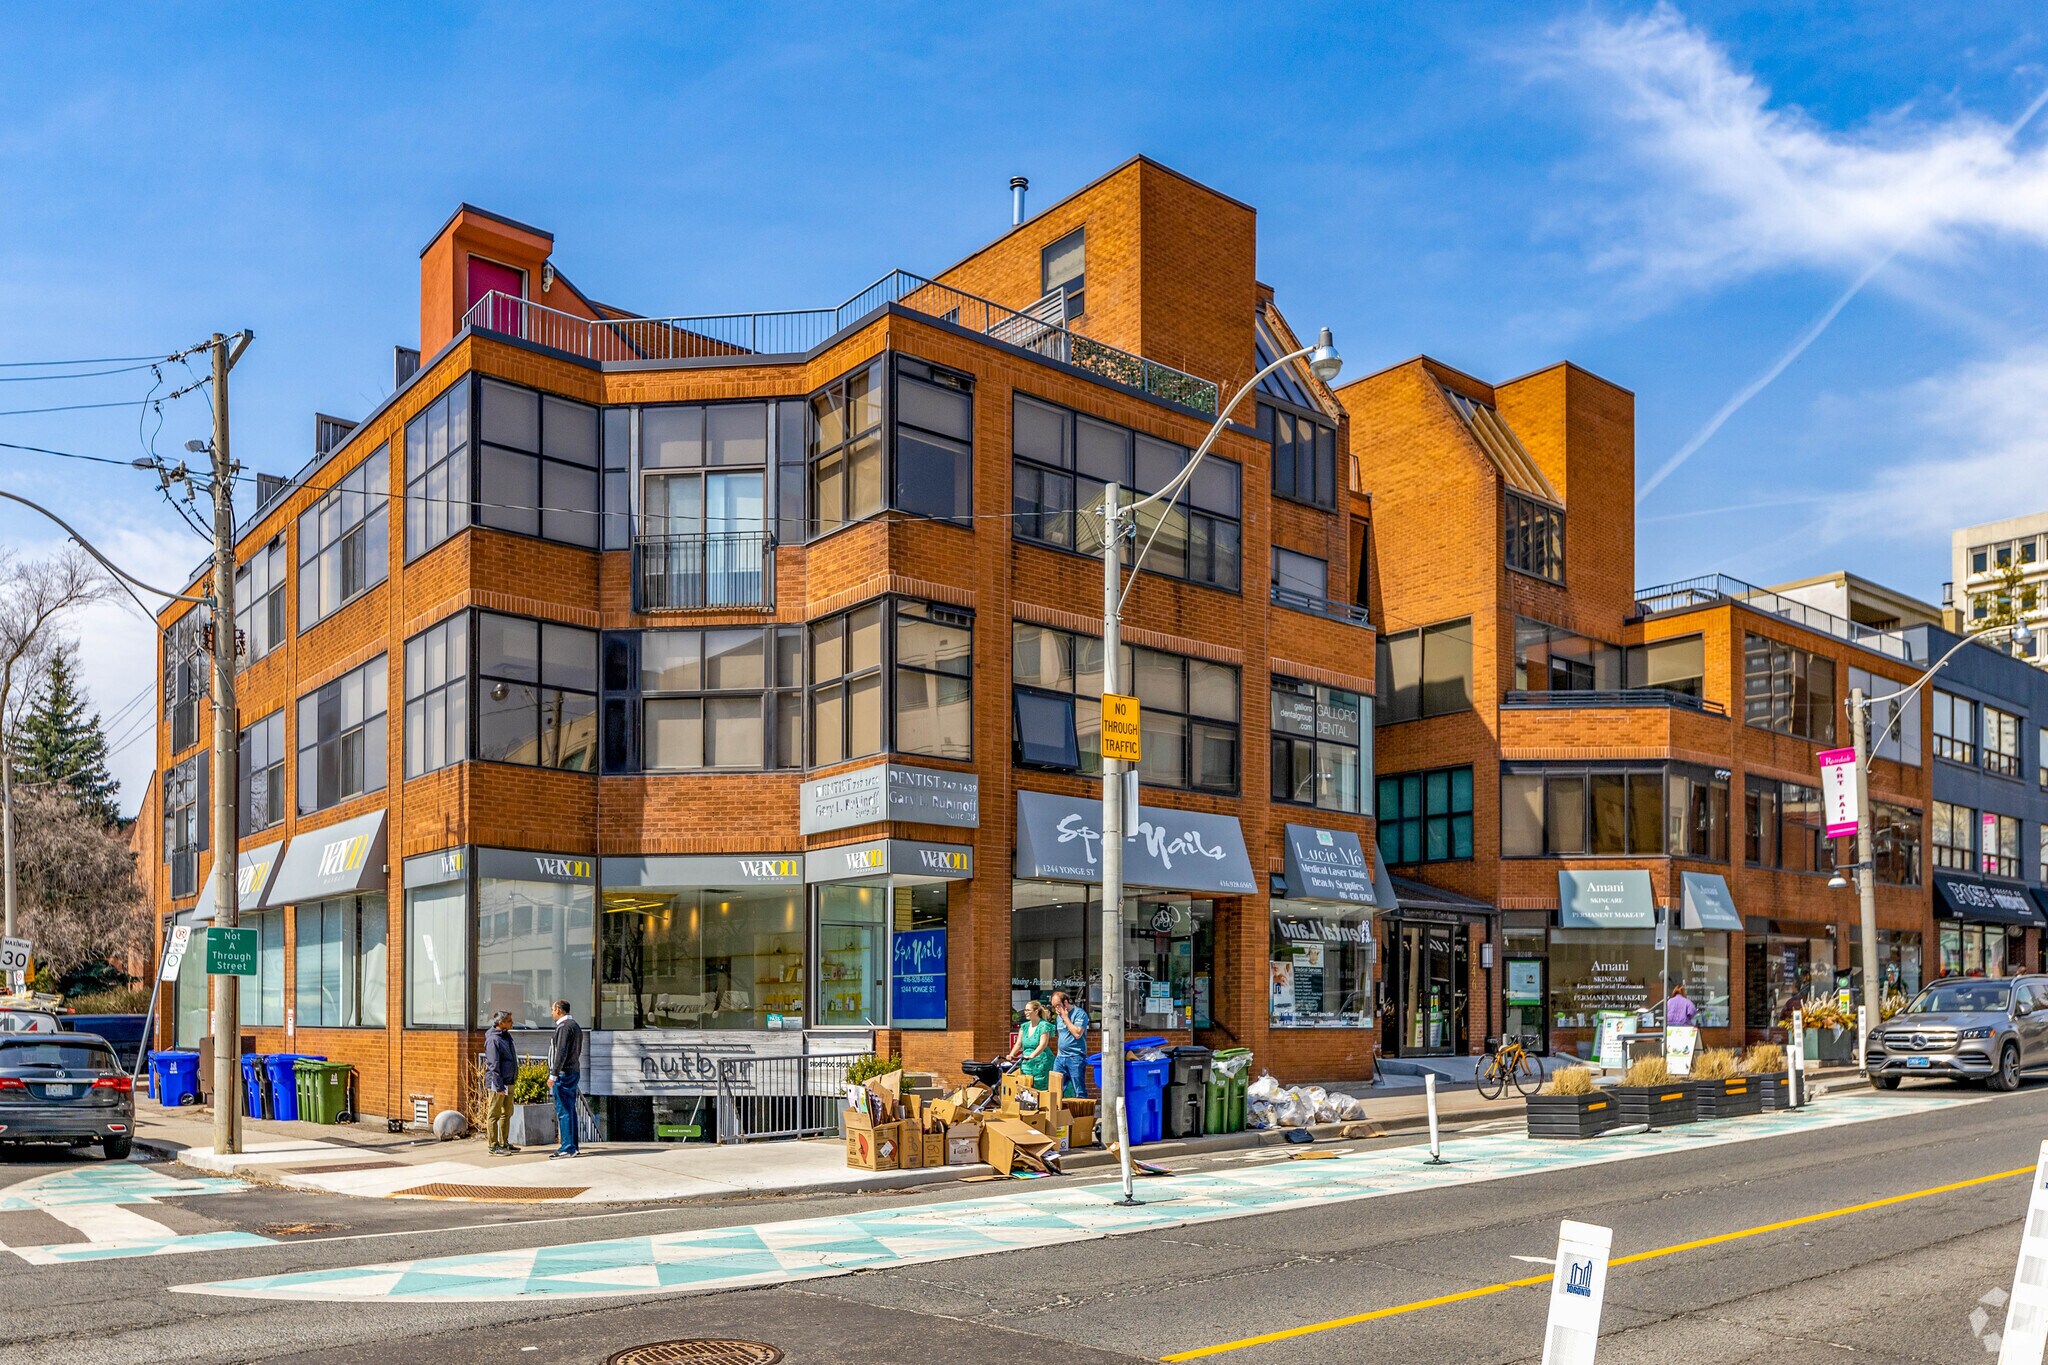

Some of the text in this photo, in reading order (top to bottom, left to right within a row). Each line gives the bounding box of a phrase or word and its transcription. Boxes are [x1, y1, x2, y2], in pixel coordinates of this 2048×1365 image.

[1114, 703, 1127, 716] NO
[1294, 703, 1313, 713] galloro
[1316, 704, 1357, 723] GALLORO
[1280, 709, 1313, 723] dentalgroup
[1104, 719, 1138, 736] THROUGH
[1299, 723, 1313, 731] .com
[1316, 721, 1349, 738] DENTAL
[1105, 738, 1137, 754] TRAFFIC
[889, 770, 941, 788] DENTIST
[959, 783, 977, 793] 1639
[1835, 766, 1843, 786] ART
[889, 791, 914, 809] Gary
[932, 795, 977, 812] Rubinoff
[1838, 794, 1846, 822] FAIR
[1138, 821, 1226, 870] Nails
[1296, 841, 1338, 863] Lucie
[1059, 865, 1086, 876] YONGE
[1085, 868, 1095, 876] ST
[1301, 863, 1367, 880] Medical Laser Clinic
[1311, 876, 1365, 892] Beauty Supplies
[1587, 882, 1624, 893] Amani
[224, 931, 241, 941] Not
[4, 939, 30, 949] MAXIMUM
[228, 942, 236, 950] A
[2, 950, 27, 968] 30
[212, 951, 252, 962] Through
[217, 961, 247, 971] Street
[1591, 960, 1629, 972] Amani
[1012, 977, 1029, 988] Waxing
[1053, 979, 1062, 988] Spa
[1567, 1283, 1591, 1297] TORONTO
